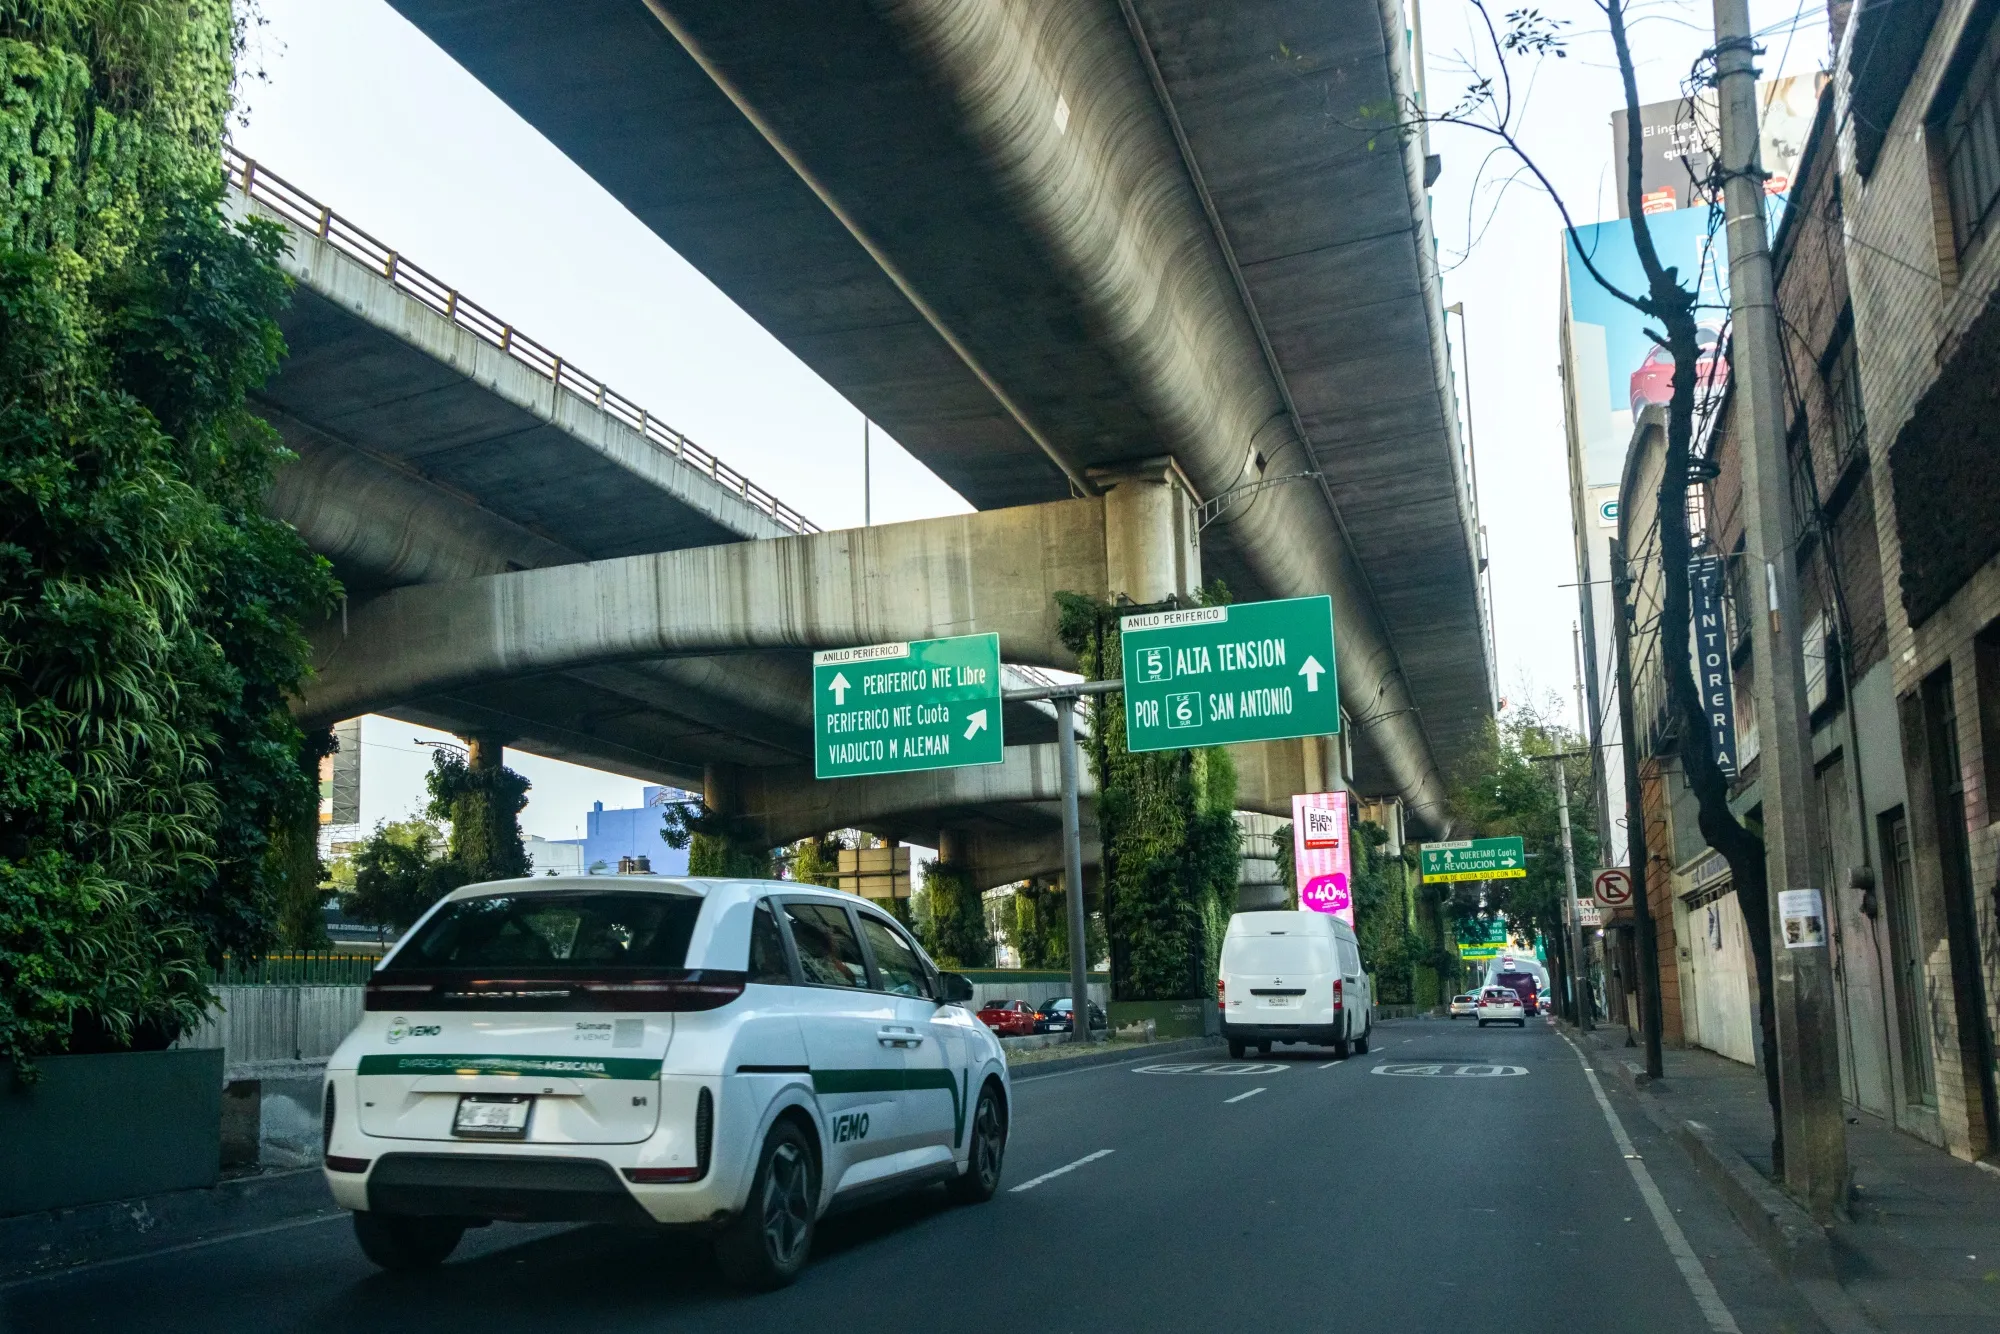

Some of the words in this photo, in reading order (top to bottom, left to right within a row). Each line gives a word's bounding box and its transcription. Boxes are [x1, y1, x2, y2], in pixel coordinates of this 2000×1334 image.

[1643, 125, 1654, 137] El
[1671, 133, 1686, 145] La
[1663, 147, 1689, 161] que
[1128, 615, 1159, 628] ANILLO
[1164, 609, 1219, 624] PERIFERICO
[823, 650, 850, 662] ANILLO
[853, 645, 899, 658] PERIFERICO
[1147, 655, 1163, 675] 5
[1176, 646, 1212, 676] ALTA
[1217, 638, 1286, 672] TENSION
[1698, 575, 1730, 765] TINTORERIA
[863, 669, 927, 696] PERIFERICO
[931, 667, 952, 689] NTE
[957, 665, 986, 686] Libre
[1135, 700, 1159, 728] POR
[1176, 700, 1193, 721] 6
[1209, 692, 1235, 722] SAN
[1239, 686, 1293, 718] ANTONIO
[827, 708, 889, 734] PERIFERICO
[893, 706, 912, 728] NTE
[917, 703, 950, 725] Cuota
[829, 740, 884, 765] VIADUCTO
[889, 738, 898, 759] M
[903, 734, 950, 758] ALEMAN
[1309, 813, 1332, 823] BUEN
[1460, 849, 1495, 860] QUERETARO
[1497, 848, 1517, 857] Cuota
[1430, 864, 1441, 872] AV
[1444, 860, 1496, 871] REVOLUCION
[1460, 872, 1477, 880] CUOTA
[1480, 871, 1495, 879] SOLO
[545, 1060, 606, 1072] MEXICANA
[832, 1112, 870, 1144] VEMO
